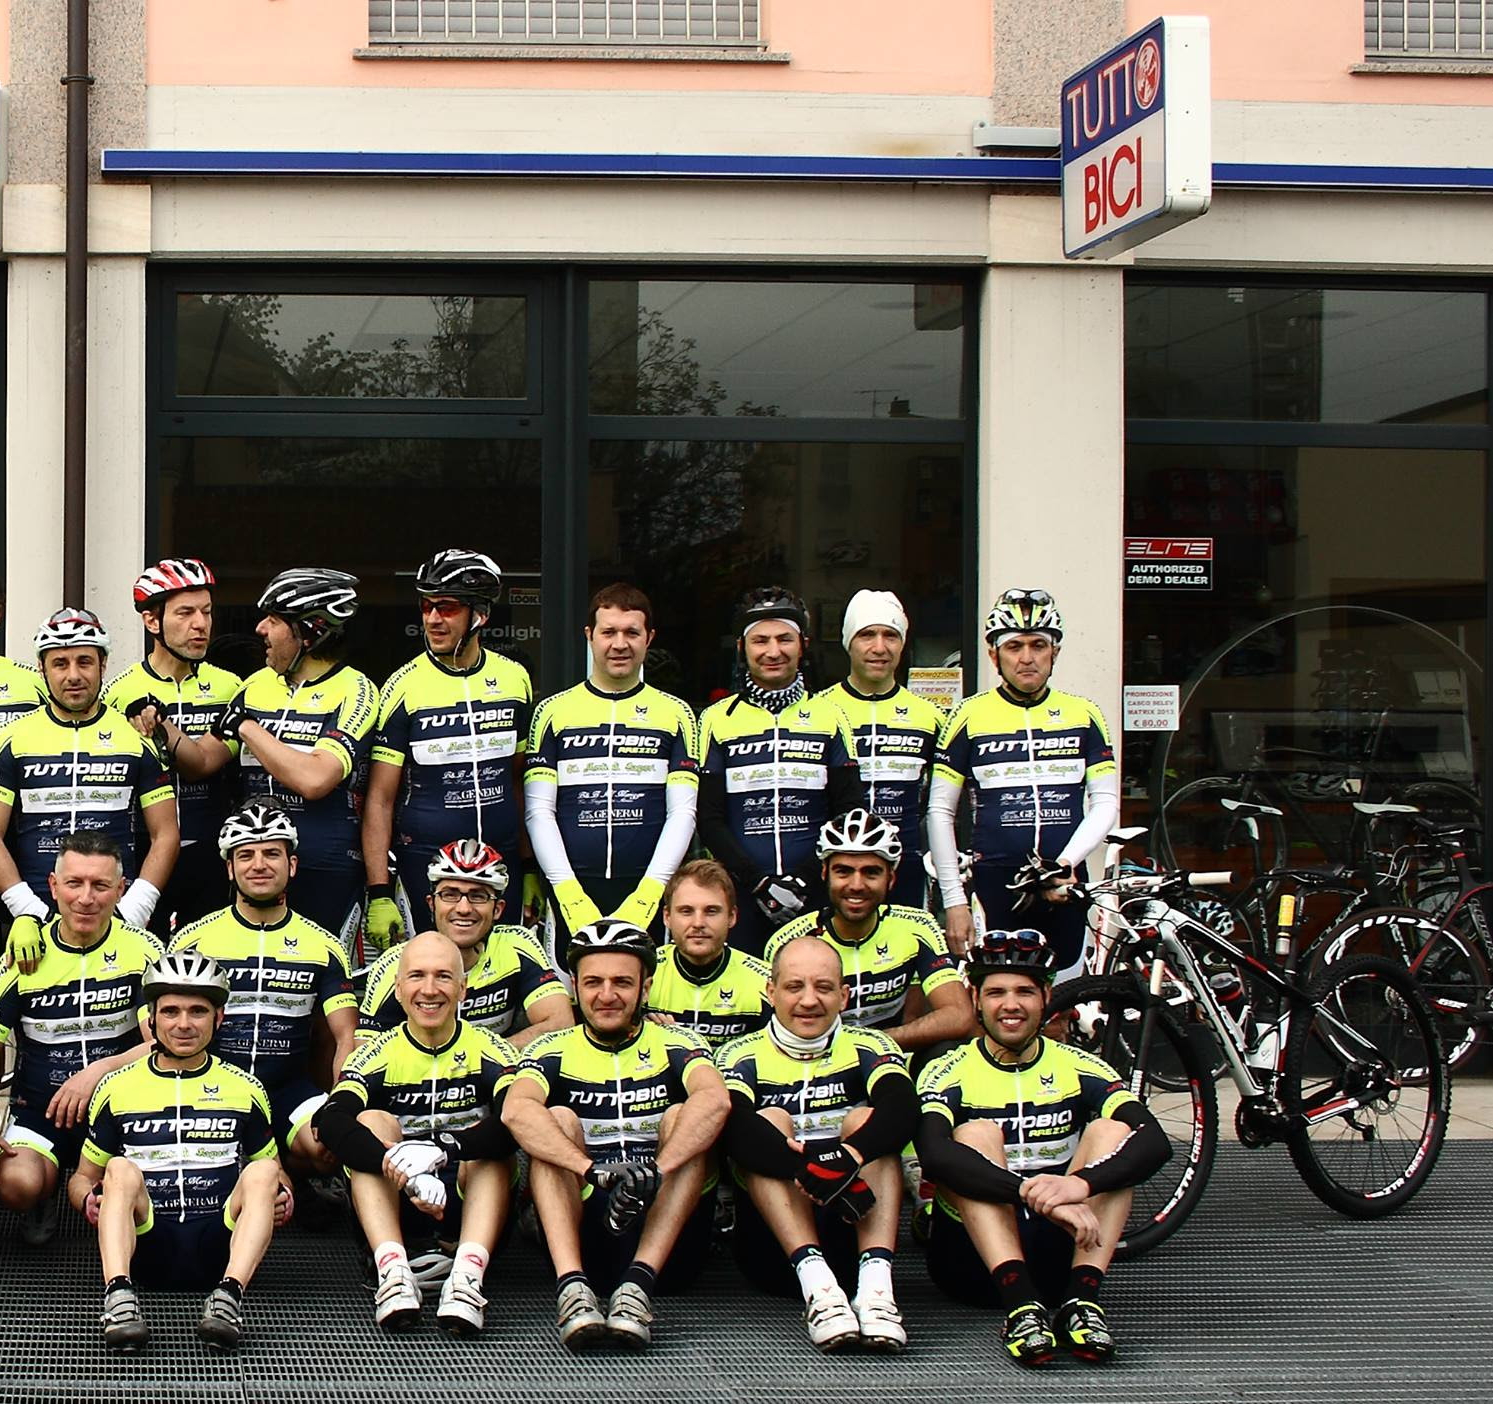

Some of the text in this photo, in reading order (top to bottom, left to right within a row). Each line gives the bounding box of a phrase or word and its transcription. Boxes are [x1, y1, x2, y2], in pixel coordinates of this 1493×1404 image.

[1084, 136, 1142, 234] BICI
[1126, 542, 1210, 555] ELITE
[1132, 565, 1204, 574] AUTHORIZED
[1127, 576, 1208, 584] DEMO DEALER
[511, 595, 539, 604] LOOK
[170, 712, 219, 724] TTOBIC
[419, 708, 515, 730] TUTTOBICI
[1133, 719, 1139, 727] €
[186, 724, 214, 732] AREZ
[259, 717, 323, 735] TTOBICI
[562, 734, 661, 749] TUTTOBICI
[728, 740, 825, 757] TUTTOBICI
[853, 735, 924, 748] TTOBICI
[977, 736, 1081, 756] TUTTOBICI
[782, 751, 822, 760] AREZZO
[23, 763, 129, 778] TUTTOBICI
[593, 808, 644, 820] GENERALI
[267, 980, 311, 990] AREZZO
[849, 973, 907, 998] TOBICI
[30, 985, 132, 1008] TUTTOBICI
[460, 988, 508, 1009] OBICI
[466, 1002, 507, 1017] AREZZO
[122, 1118, 237, 1134] TUTTOBICI
[978, 1109, 1073, 1130] TTOBICI
[186, 1131, 234, 1139] AREZZO
[1190, 1120, 1204, 1164] CREST
[1404, 1146, 1426, 1178] CREST
